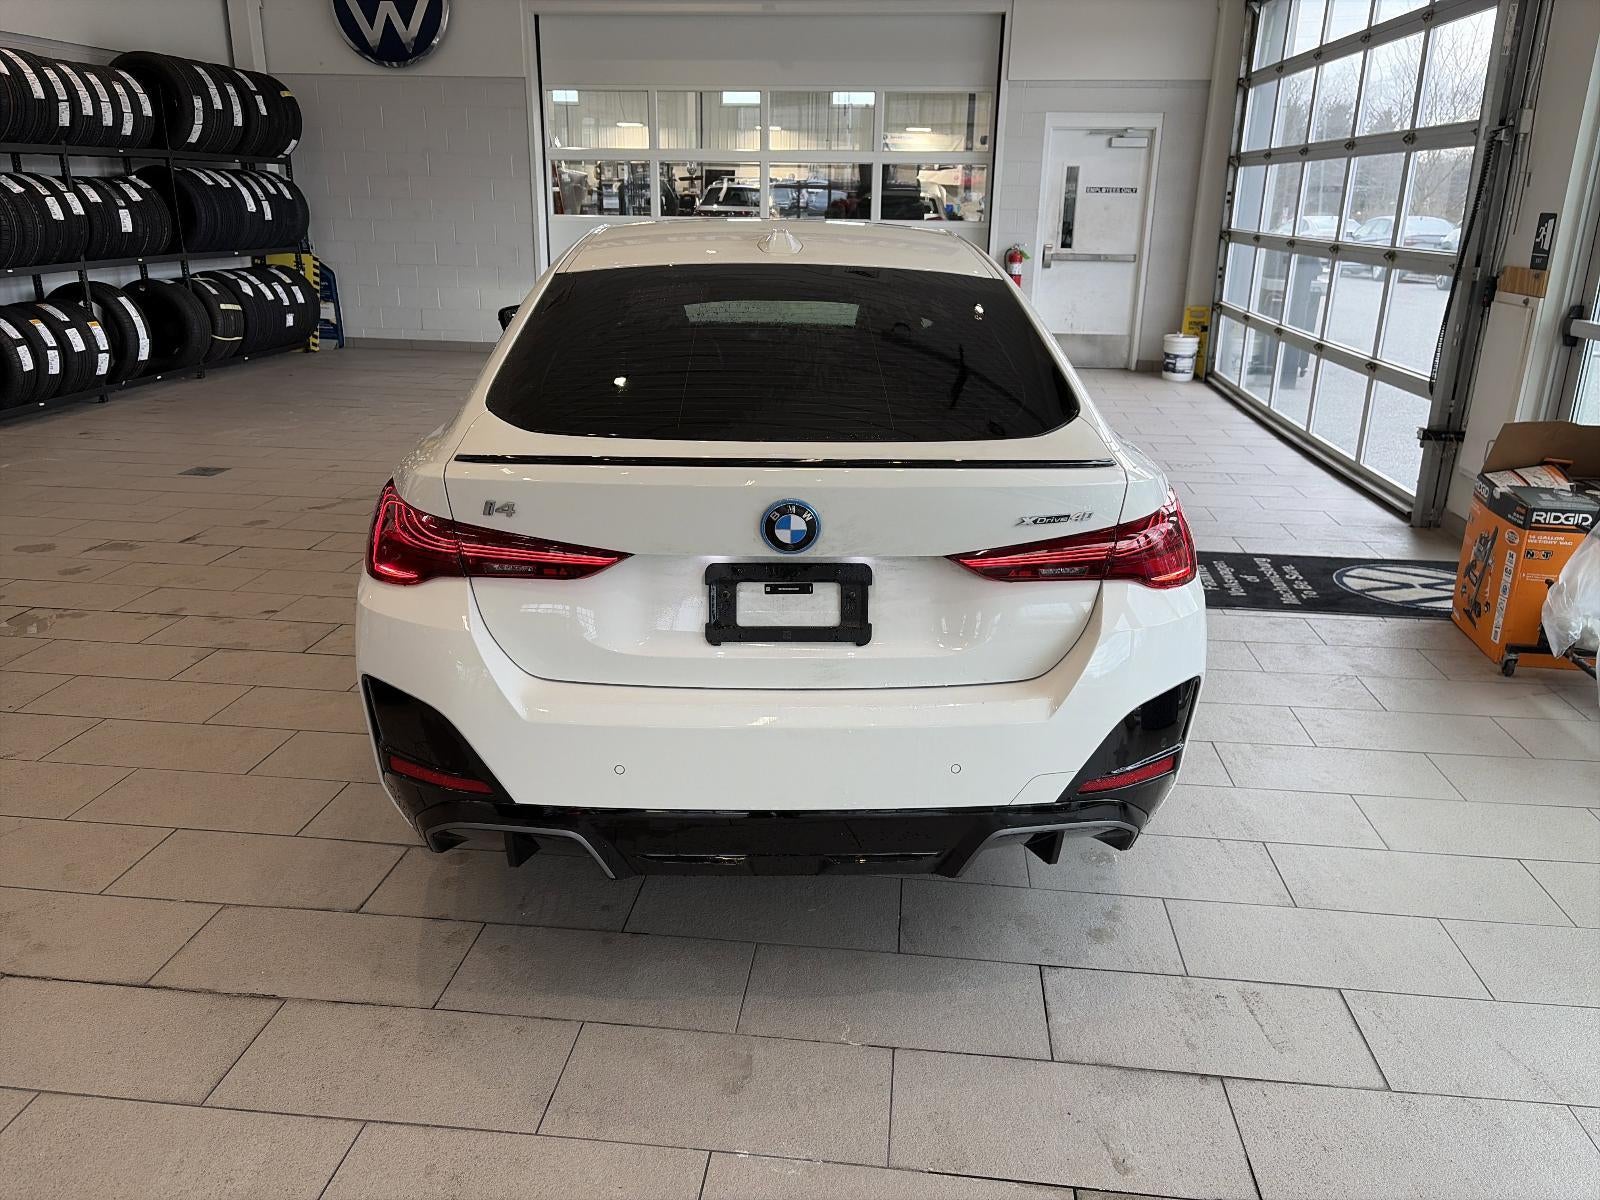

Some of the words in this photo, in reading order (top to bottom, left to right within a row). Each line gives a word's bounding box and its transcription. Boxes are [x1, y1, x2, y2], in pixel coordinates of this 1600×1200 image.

[483, 500, 516, 517] i4
[769, 504, 813, 522] BMW
[1531, 511, 1593, 526] RIDGID
[1293, 580, 1313, 590] Be
